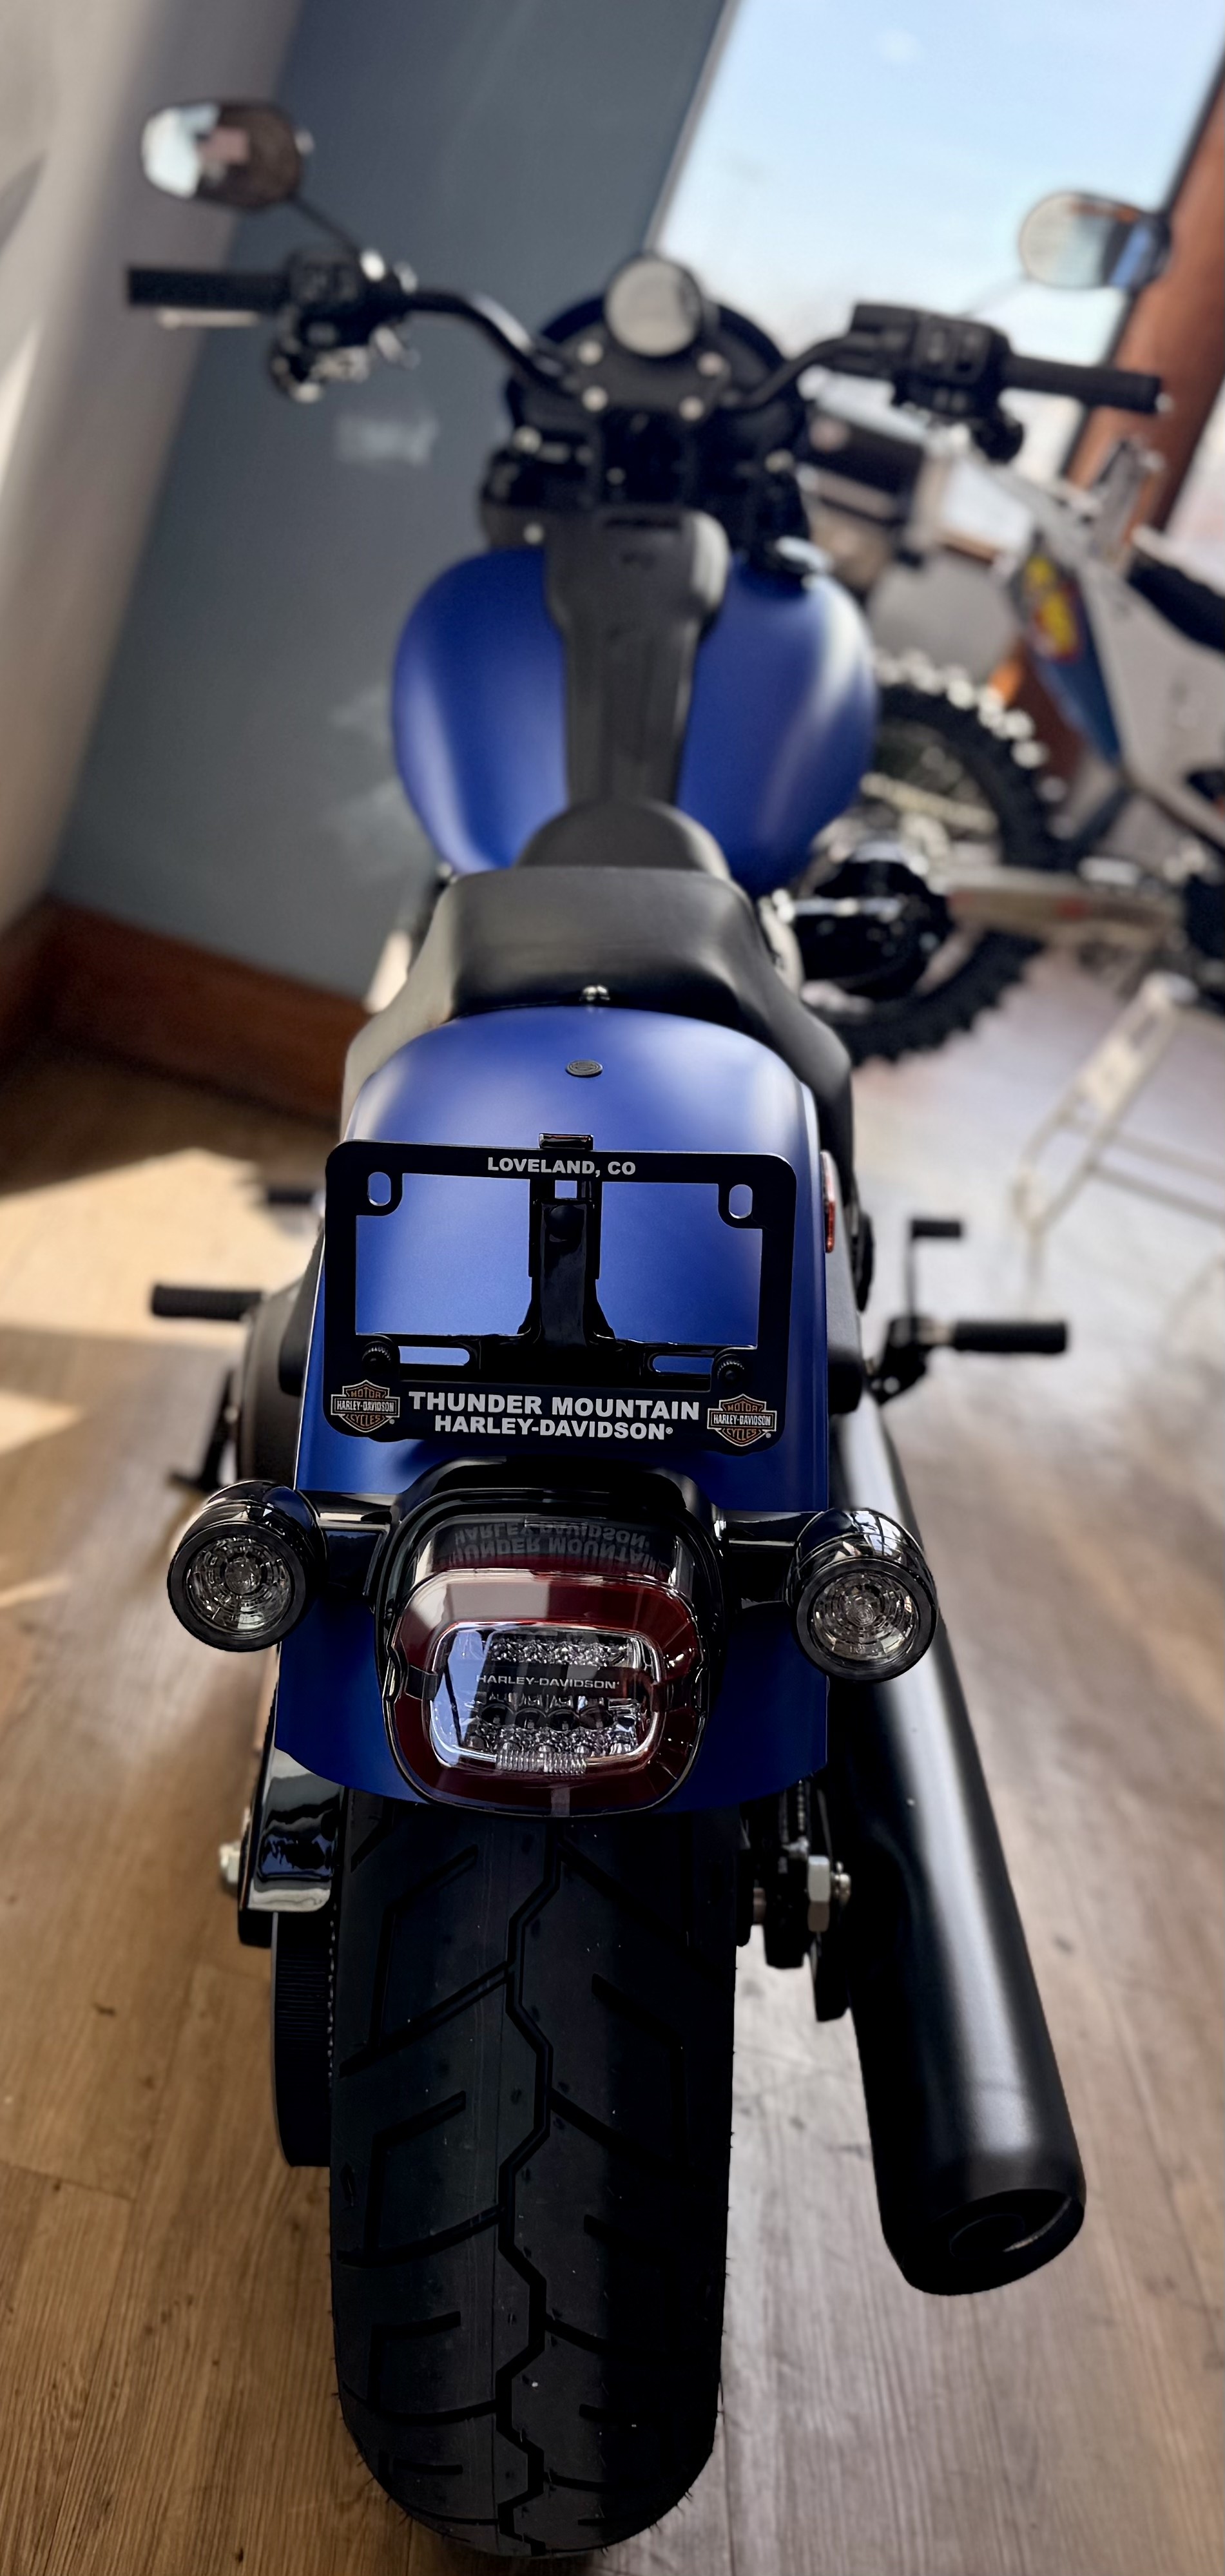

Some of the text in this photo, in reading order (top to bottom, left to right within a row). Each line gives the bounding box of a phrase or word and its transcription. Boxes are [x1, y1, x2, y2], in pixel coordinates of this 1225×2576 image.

[488, 1157, 636, 1177] LOVELAND, CO
[351, 1387, 381, 1398] MOTOR
[336, 1400, 395, 1412] HARLEY-DAVIDSON
[409, 1391, 700, 1420] THUNDER MOUNTAIN
[728, 1401, 758, 1412] MOTOR
[350, 1414, 381, 1427] CYCLES
[713, 1414, 771, 1426] HARLEY-DAVIDSON
[726, 1428, 757, 1441] CYCLES
